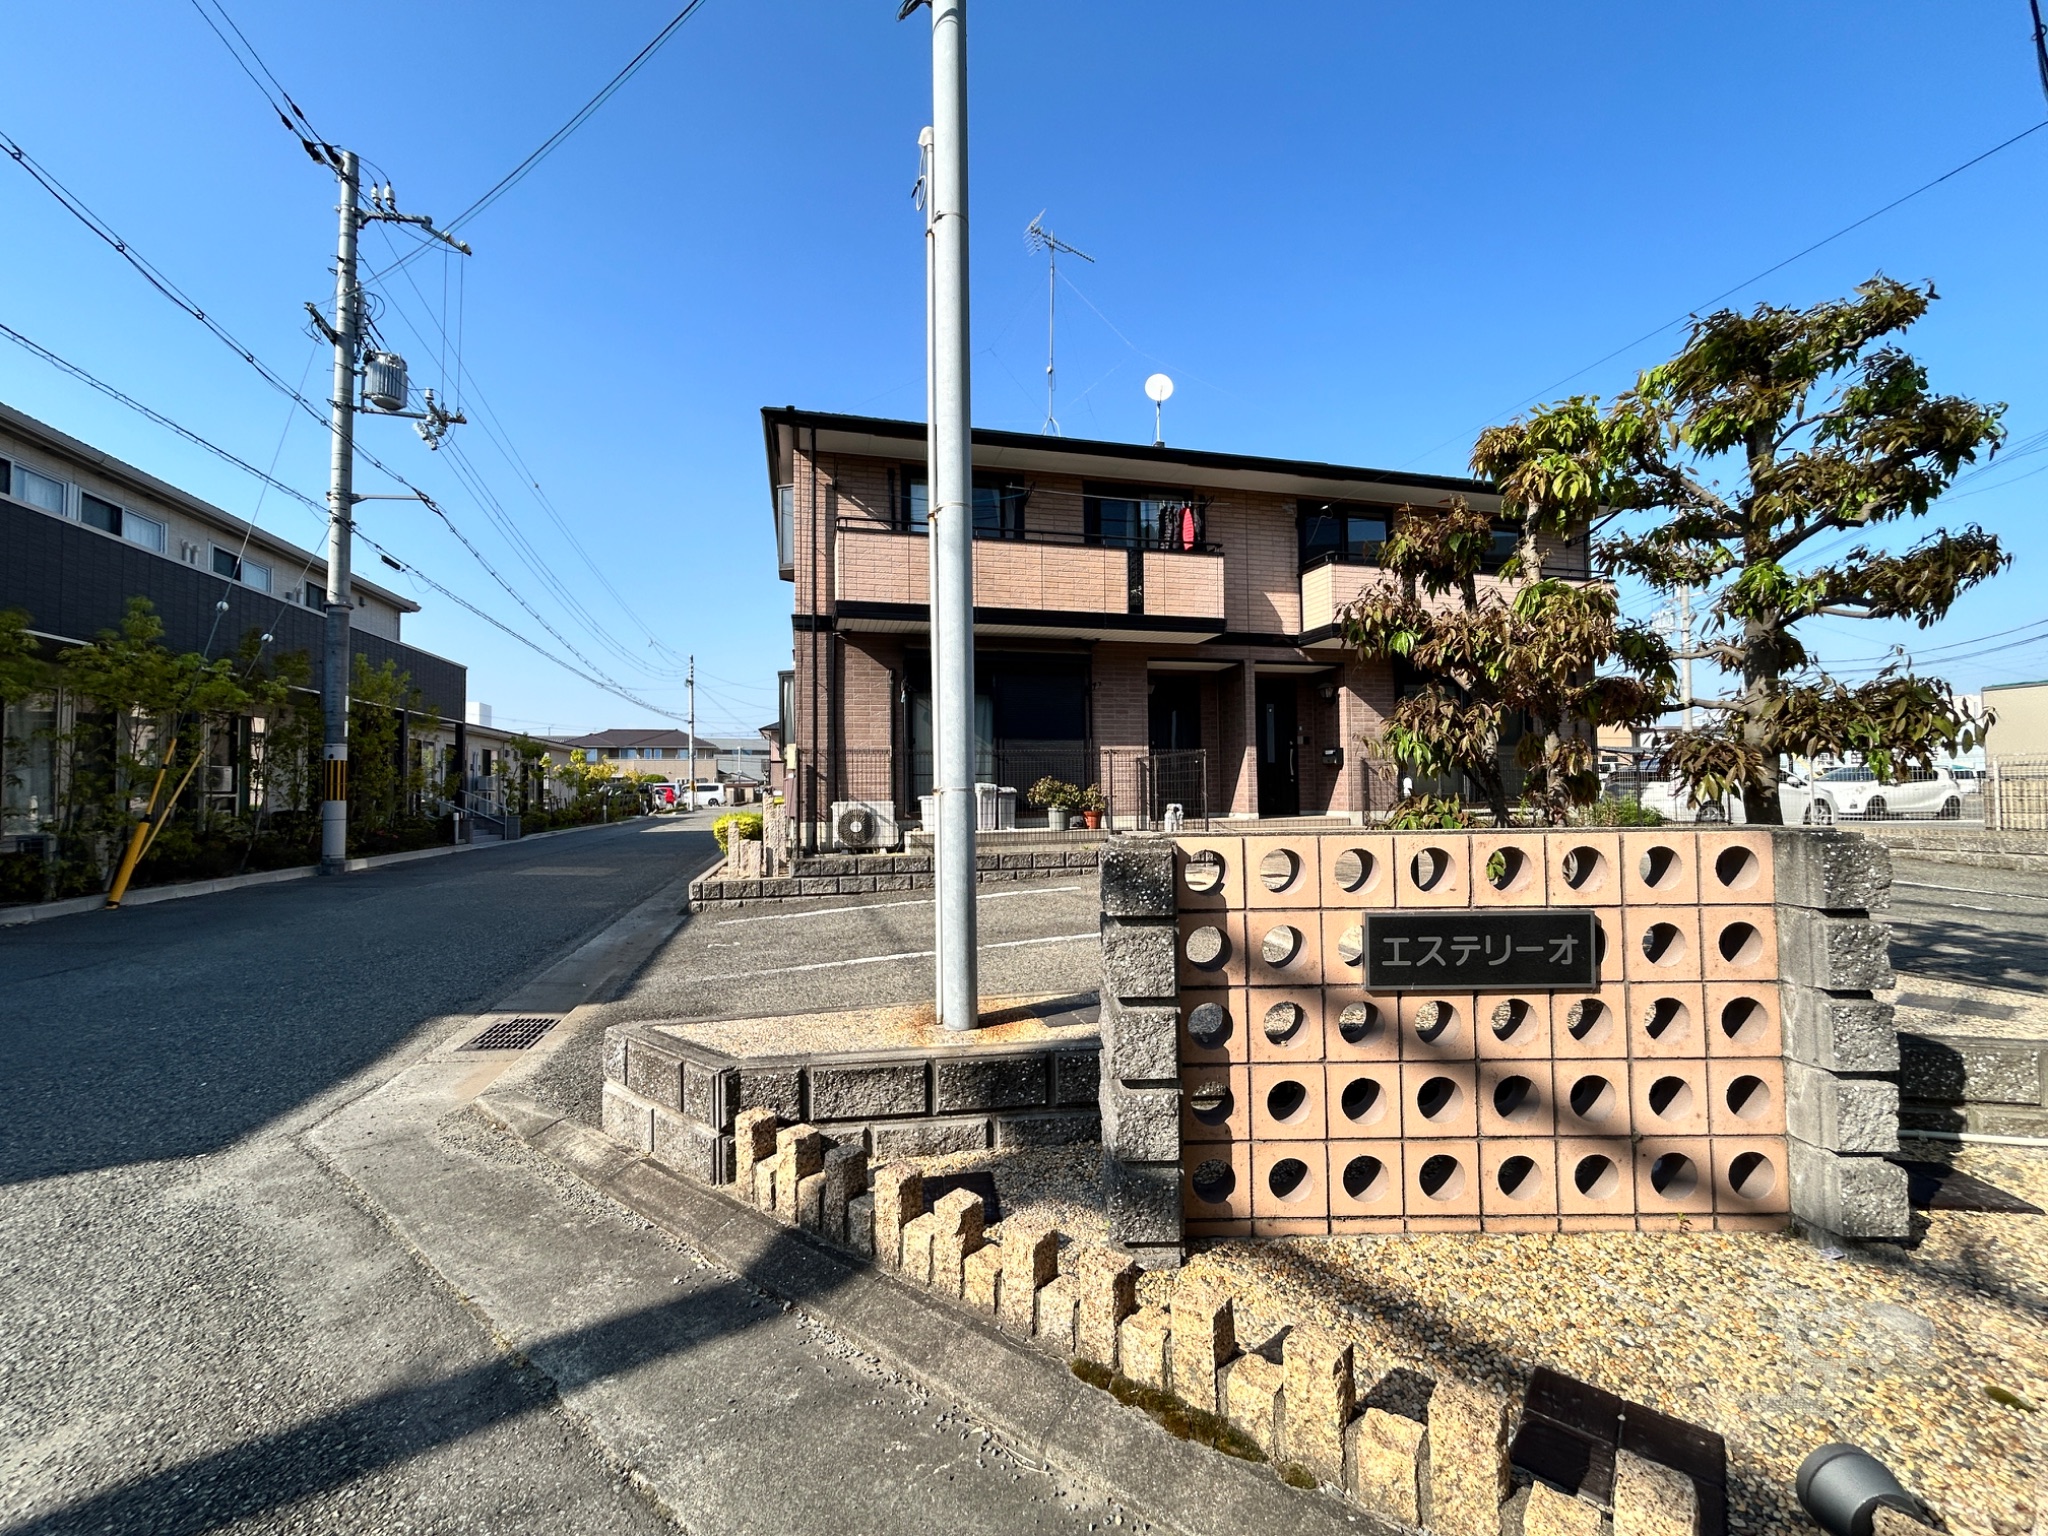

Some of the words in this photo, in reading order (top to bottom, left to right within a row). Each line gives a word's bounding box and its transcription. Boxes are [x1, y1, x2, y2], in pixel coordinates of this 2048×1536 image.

[1381, 934, 1579, 967] エステリーオ
